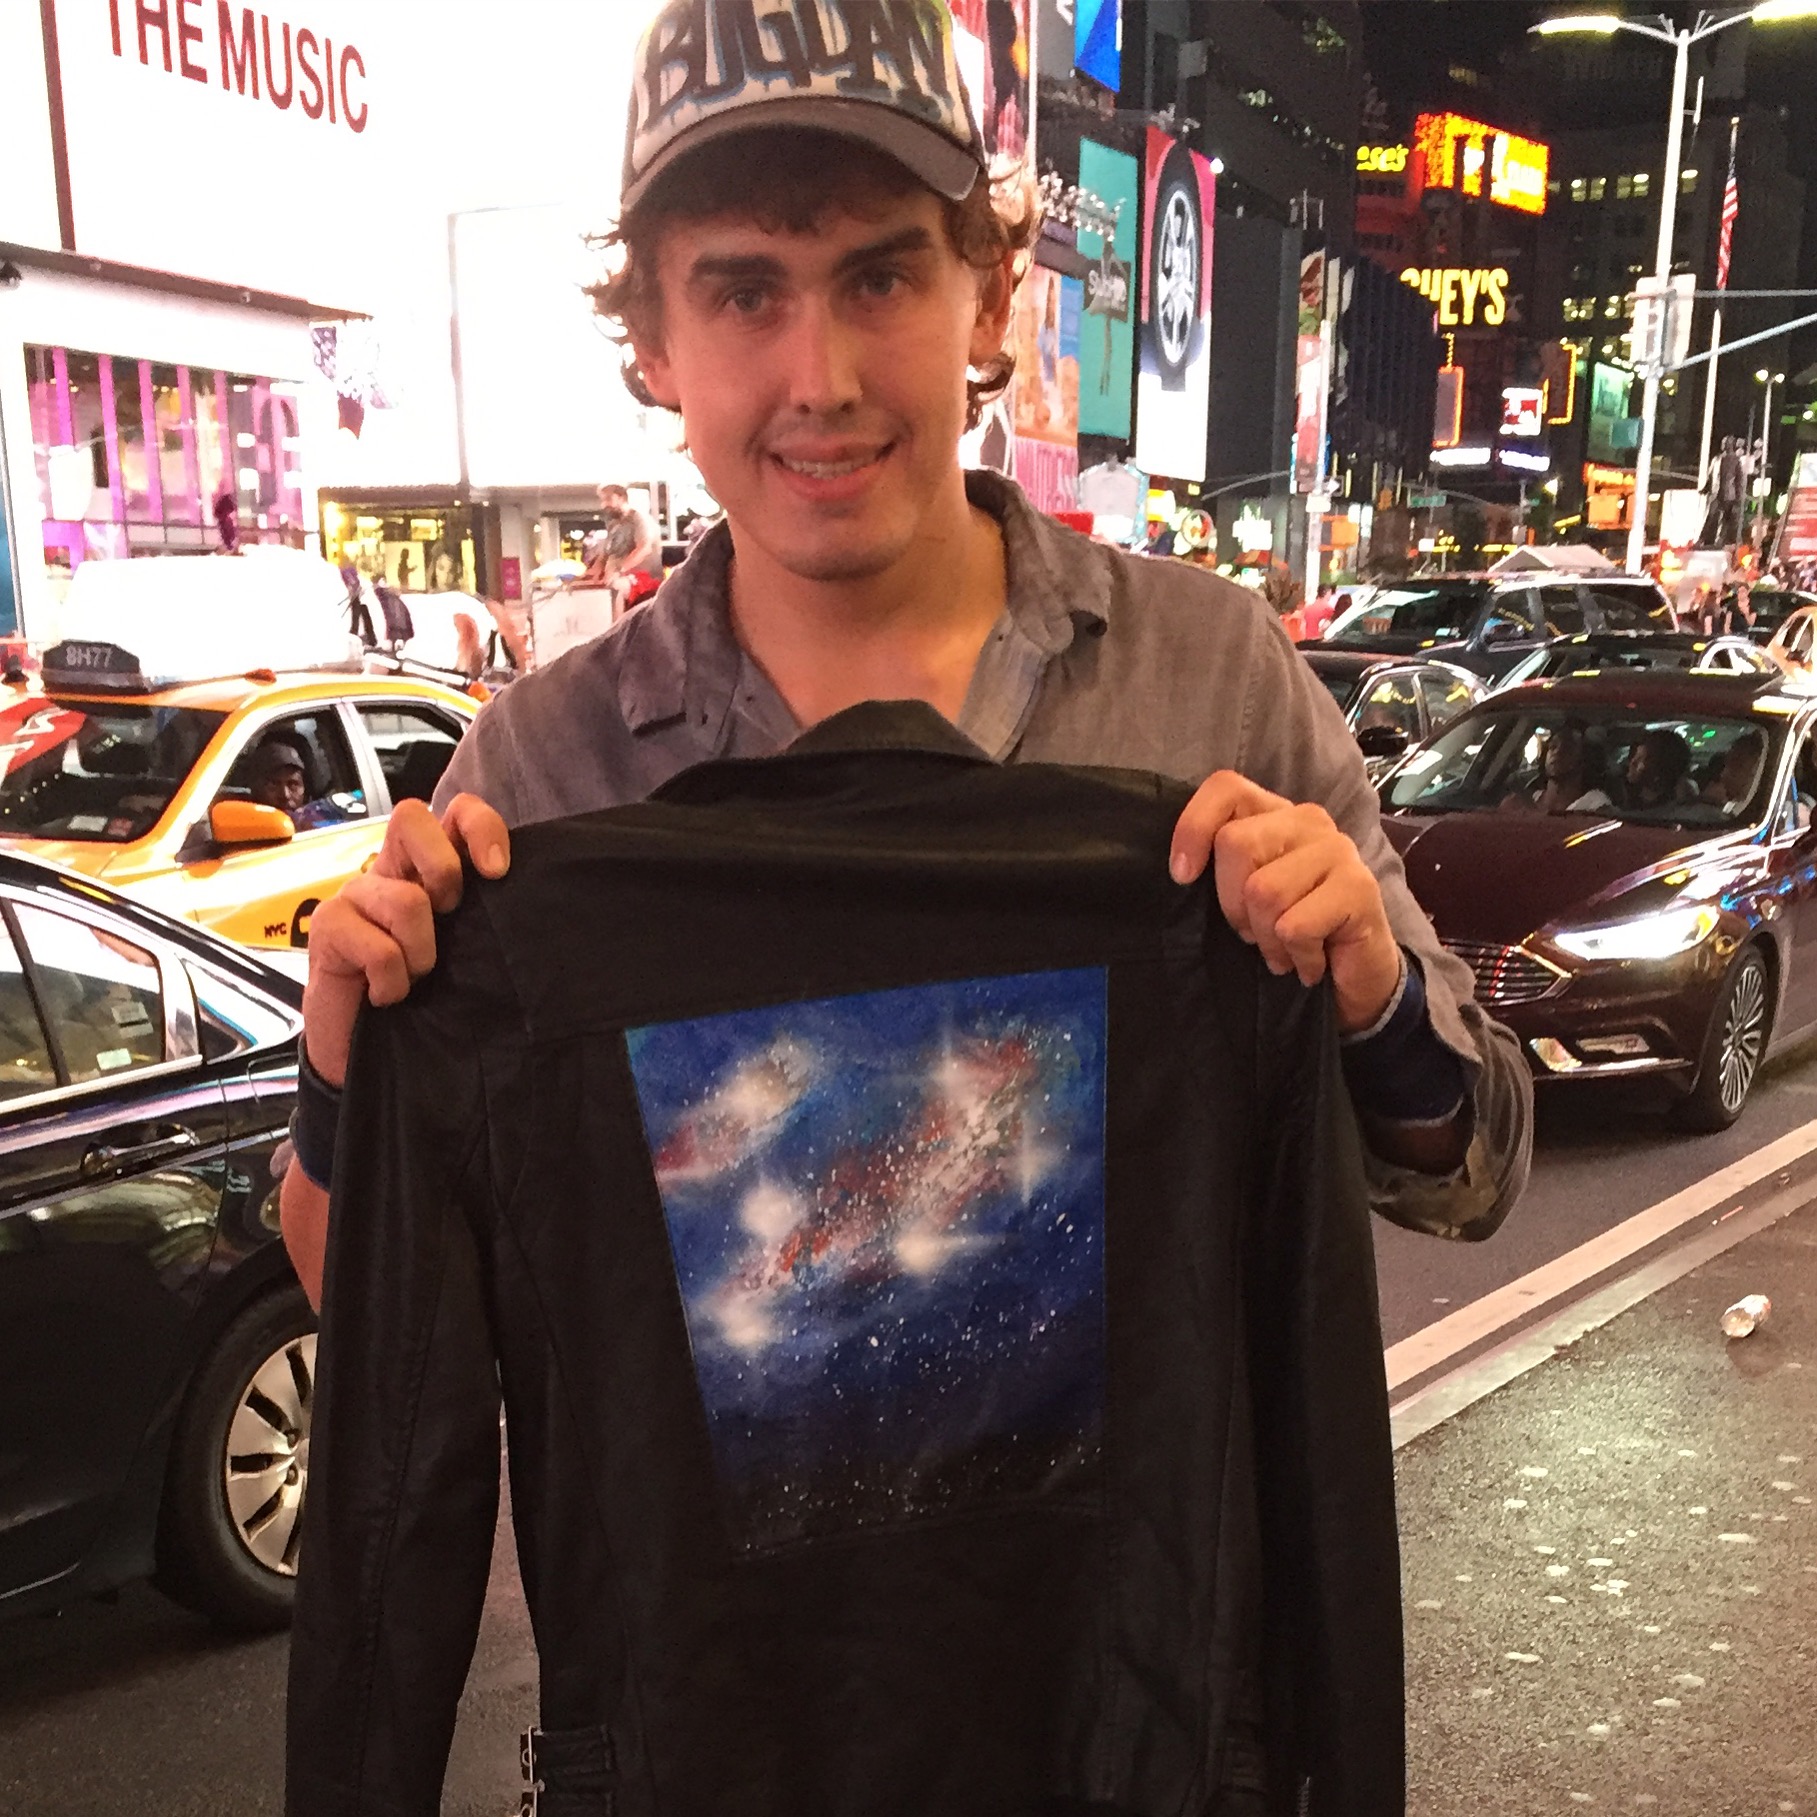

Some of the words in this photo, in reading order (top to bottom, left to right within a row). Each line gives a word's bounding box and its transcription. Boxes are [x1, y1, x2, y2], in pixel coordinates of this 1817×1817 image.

[108, 0, 208, 84] THE
[217, 0, 368, 133] MUSIC
[65, 644, 113, 668] 8H77
[263, 921, 287, 939] NYC
